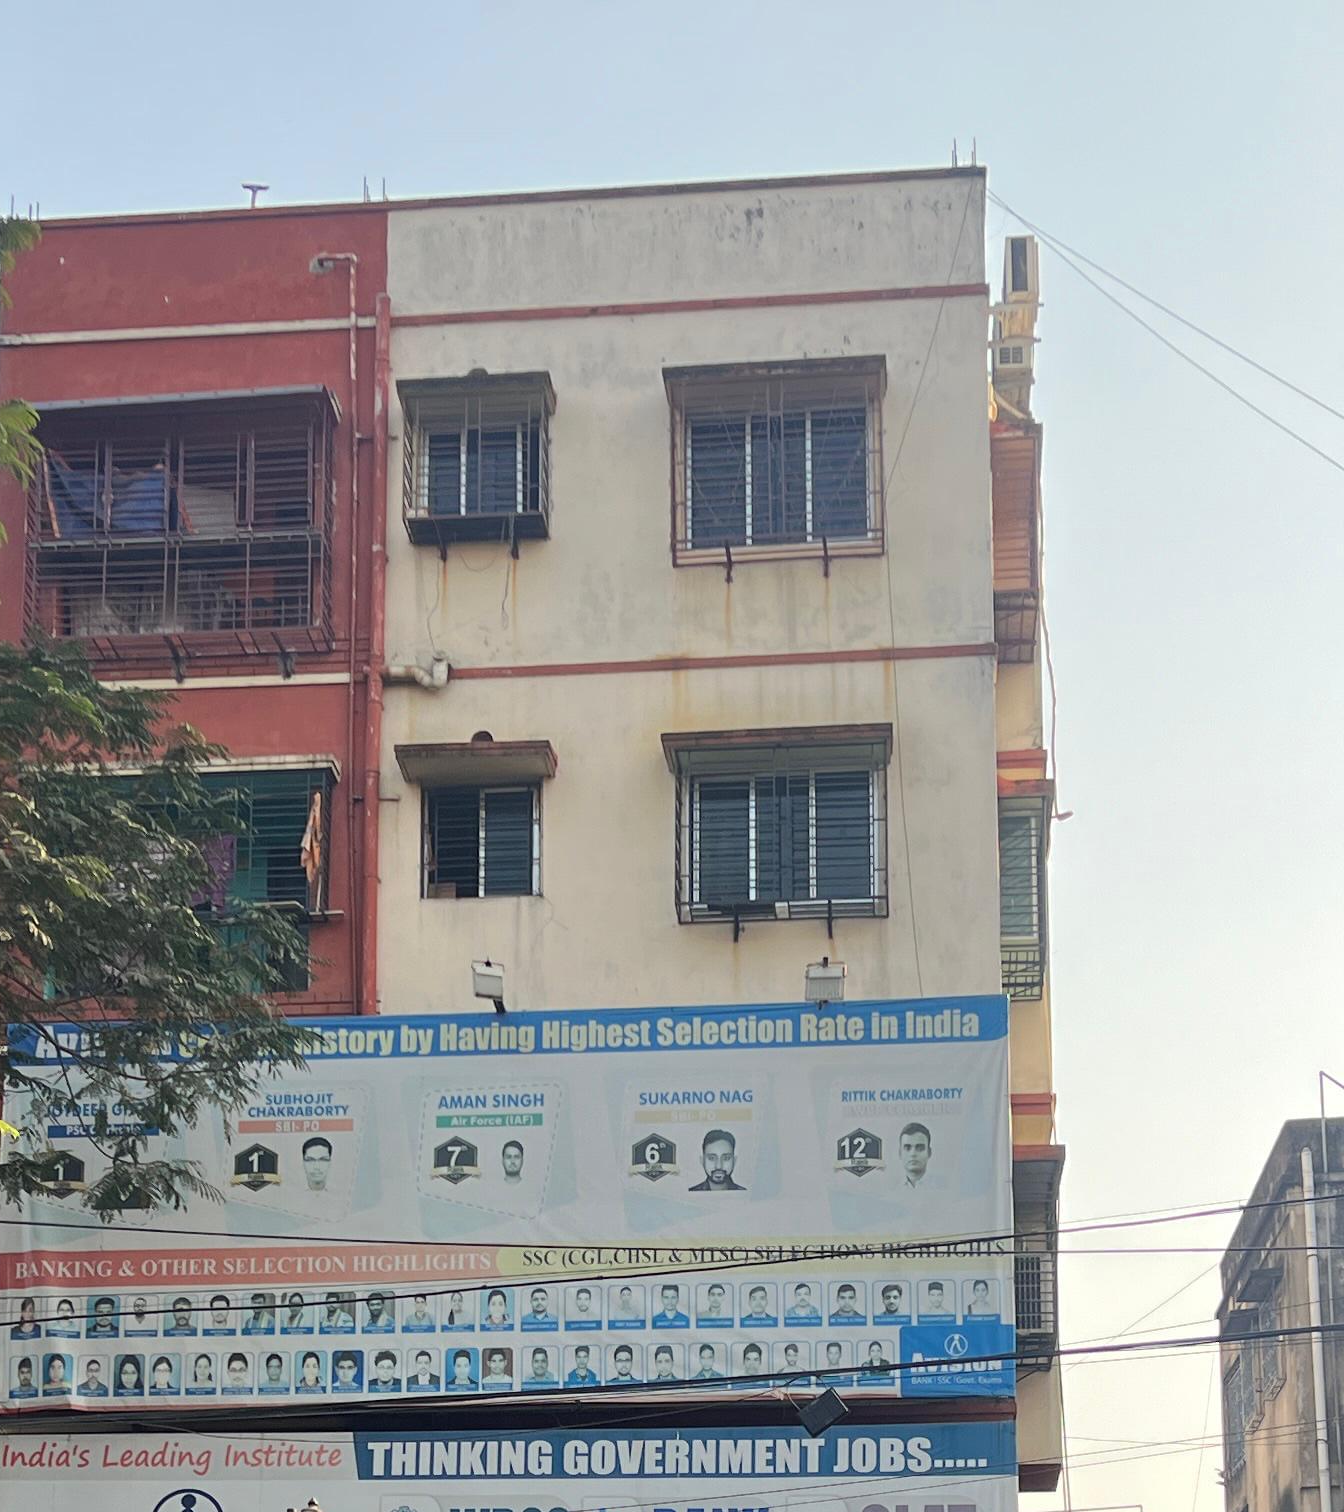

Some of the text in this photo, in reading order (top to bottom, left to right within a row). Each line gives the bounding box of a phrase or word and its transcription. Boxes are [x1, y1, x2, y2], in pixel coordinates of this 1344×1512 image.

[400, 1025, 433, 1055] by
[439, 1022, 536, 1053] Having
[542, 1018, 651, 1052] Highest
[657, 1015, 793, 1046] Selection
[800, 1013, 865, 1042] Rate
[871, 1012, 899, 1040] in
[906, 1009, 980, 1039] India
[265, 1093, 334, 1105] SUBHOJIT
[438, 1093, 545, 1109] AMAN SINGH
[639, 1089, 753, 1105] SUKARNO NAG
[841, 1087, 964, 1102] RITTIK CHAKRABORTY
[248, 1105, 349, 1118] CHAKRABORTY
[451, 1115, 533, 1126] Air Force (IAF)
[522, 1250, 556, 1266] SSC
[668, 1248, 682, 1264] &
[15, 1252, 491, 1280] BANKING & OTHER SELECTION HIGHLIGHTS
[2, 1441, 343, 1476] India's Leading Institute
[367, 1440, 553, 1476] THINKING
[563, 1438, 825, 1476] GOVERNMENT
